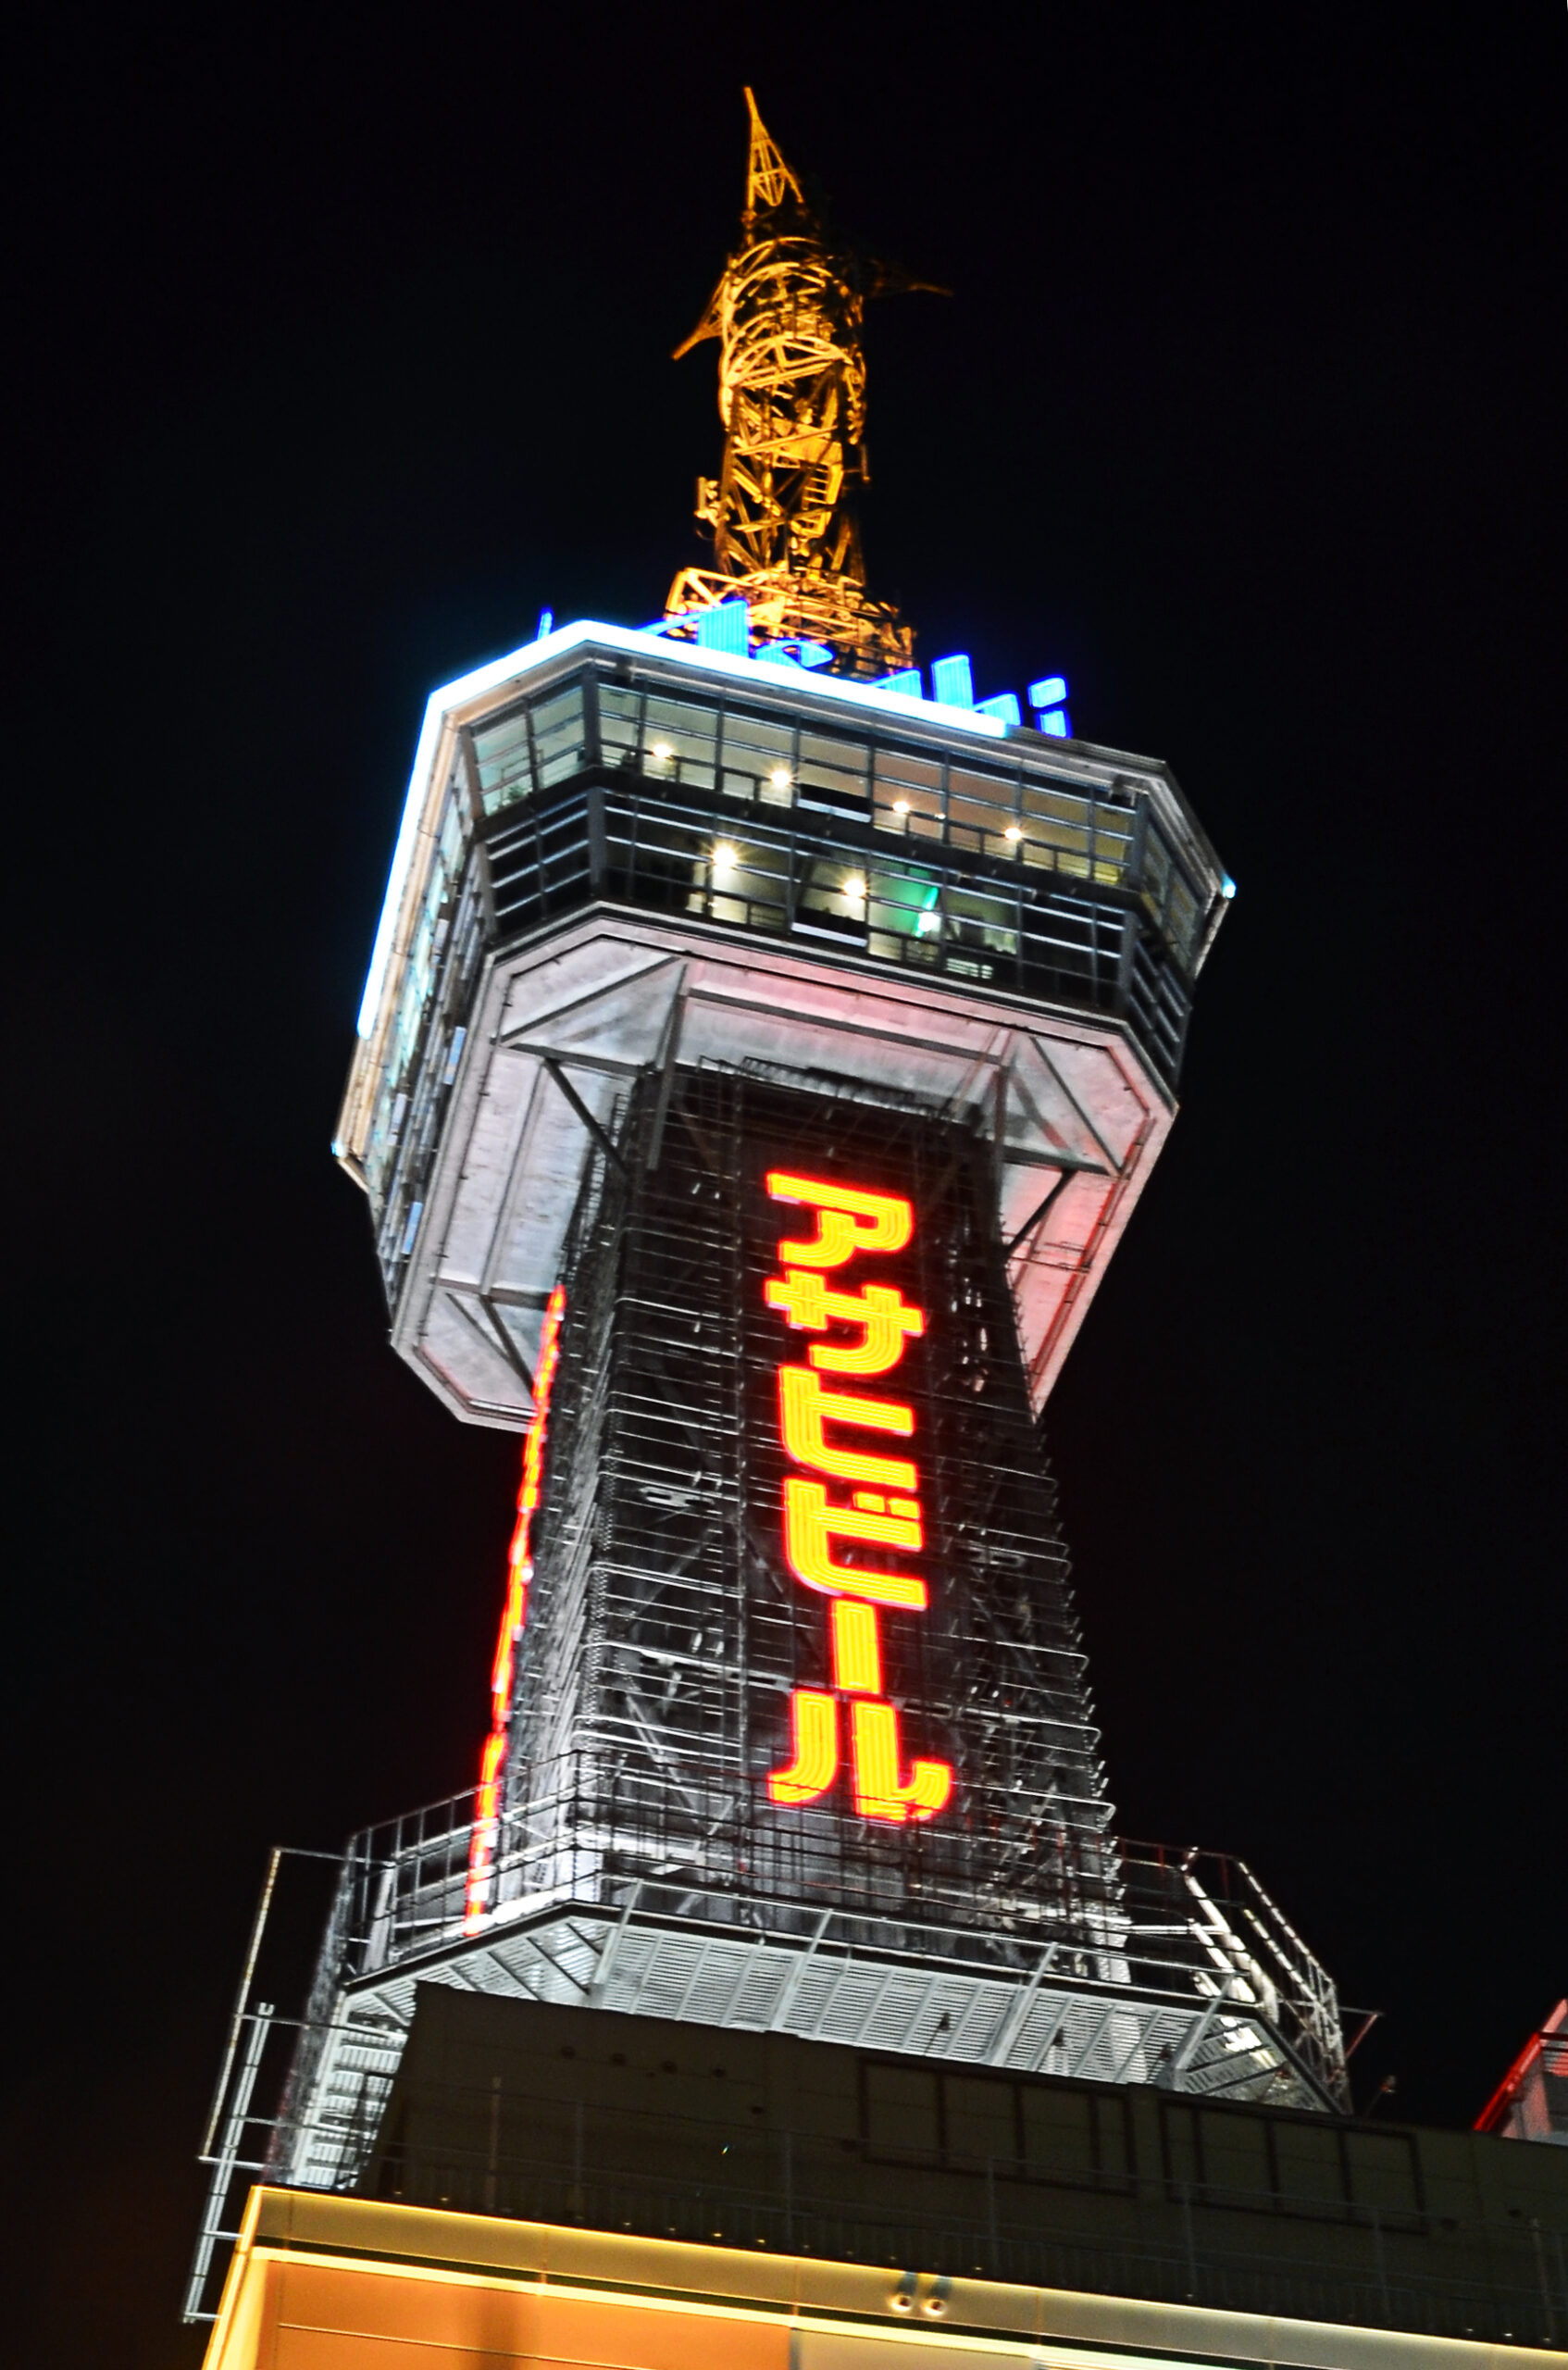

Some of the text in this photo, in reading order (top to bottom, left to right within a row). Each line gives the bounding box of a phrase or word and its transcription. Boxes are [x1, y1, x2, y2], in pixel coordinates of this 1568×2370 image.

[765, 1170, 952, 1823] アサヒビール
